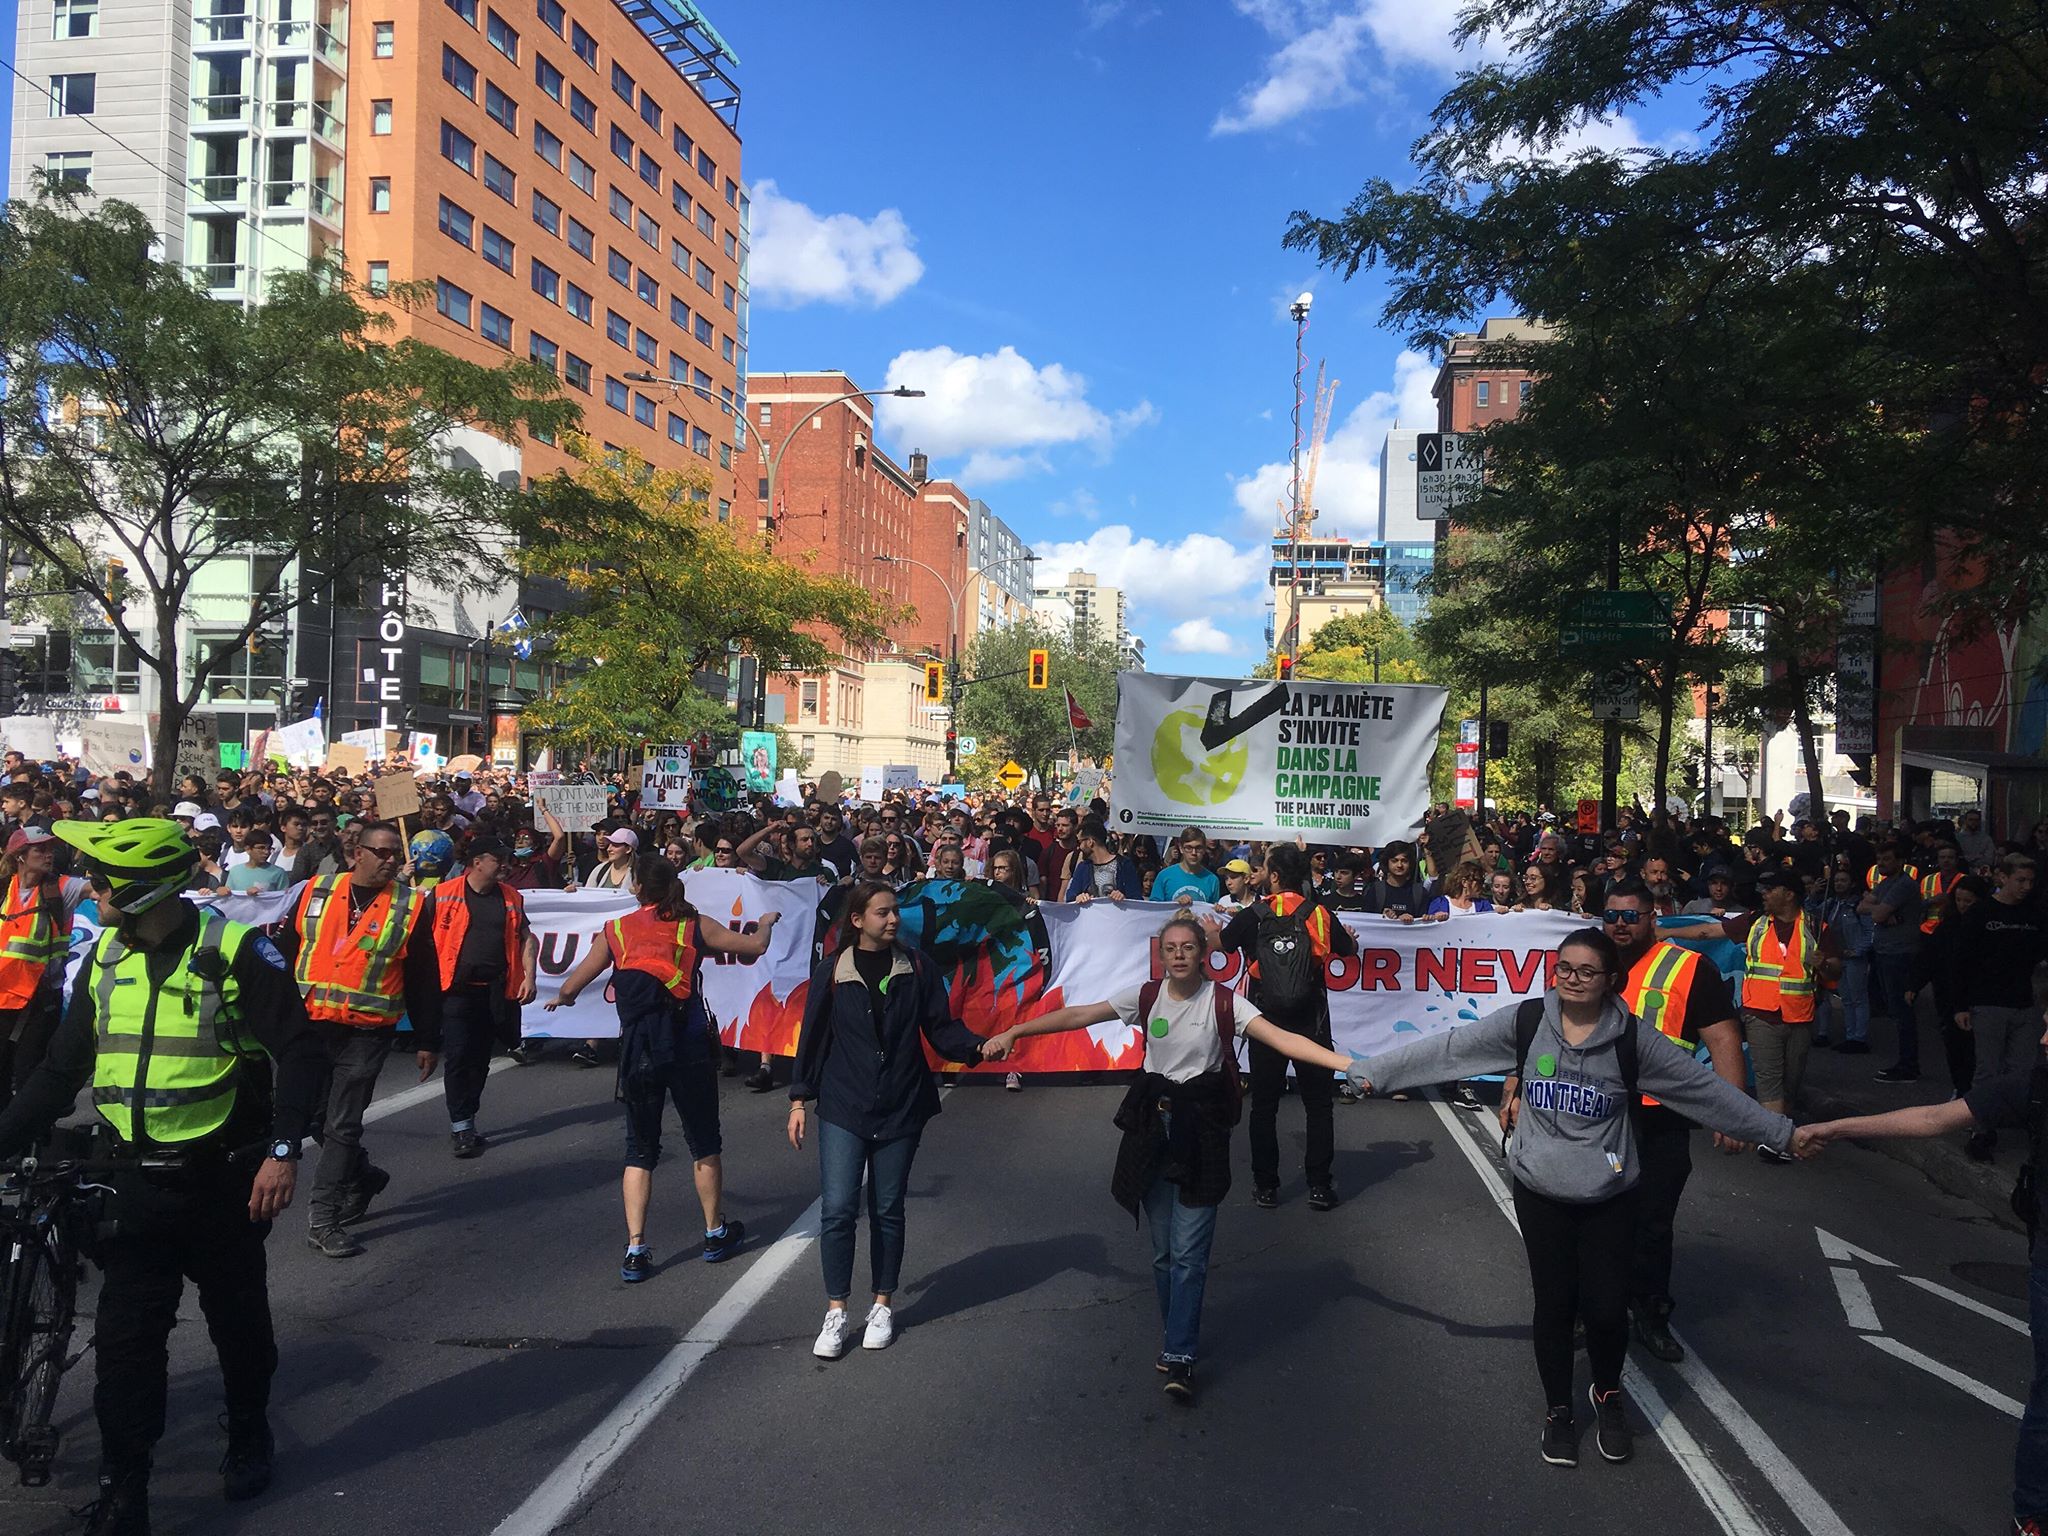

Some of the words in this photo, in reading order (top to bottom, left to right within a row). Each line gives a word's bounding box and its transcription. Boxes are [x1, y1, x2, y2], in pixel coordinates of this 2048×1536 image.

[1445, 456, 1480, 470] TAXI
[1422, 474, 1446, 484] 6h30
[1420, 485, 1446, 494] 15h30
[1425, 494, 1443, 504] LUN
[380, 582, 404, 730] HÔTEL
[46, 699, 102, 710] Couche-Tard
[1280, 692, 1304, 717] LA
[1304, 690, 1394, 721] PLANÈTE
[1278, 719, 1361, 746] S'INVITE
[647, 745, 689, 759] THERE'S
[1277, 746, 1332, 773] DANS
[1333, 748, 1358, 773] LA
[644, 773, 687, 790] PLANET
[1275, 773, 1382, 802] CAMPAGNE
[583, 787, 607, 800] WANT
[657, 788, 666, 802] B
[553, 803, 565, 814] BE
[566, 802, 584, 813] THE
[585, 802, 605, 813] NEXT
[1275, 801, 1295, 816] THE
[1296, 802, 1336, 816] PLANET
[1337, 804, 1370, 817] JOINS
[1275, 815, 1295, 828] THE
[1296, 816, 1351, 831] CAMPAIGN
[816, 942, 824, 960] 9
[1038, 948, 1050, 966] 3
[1323, 948, 1404, 992] OR
[1594, 1079, 1607, 1090] DE
